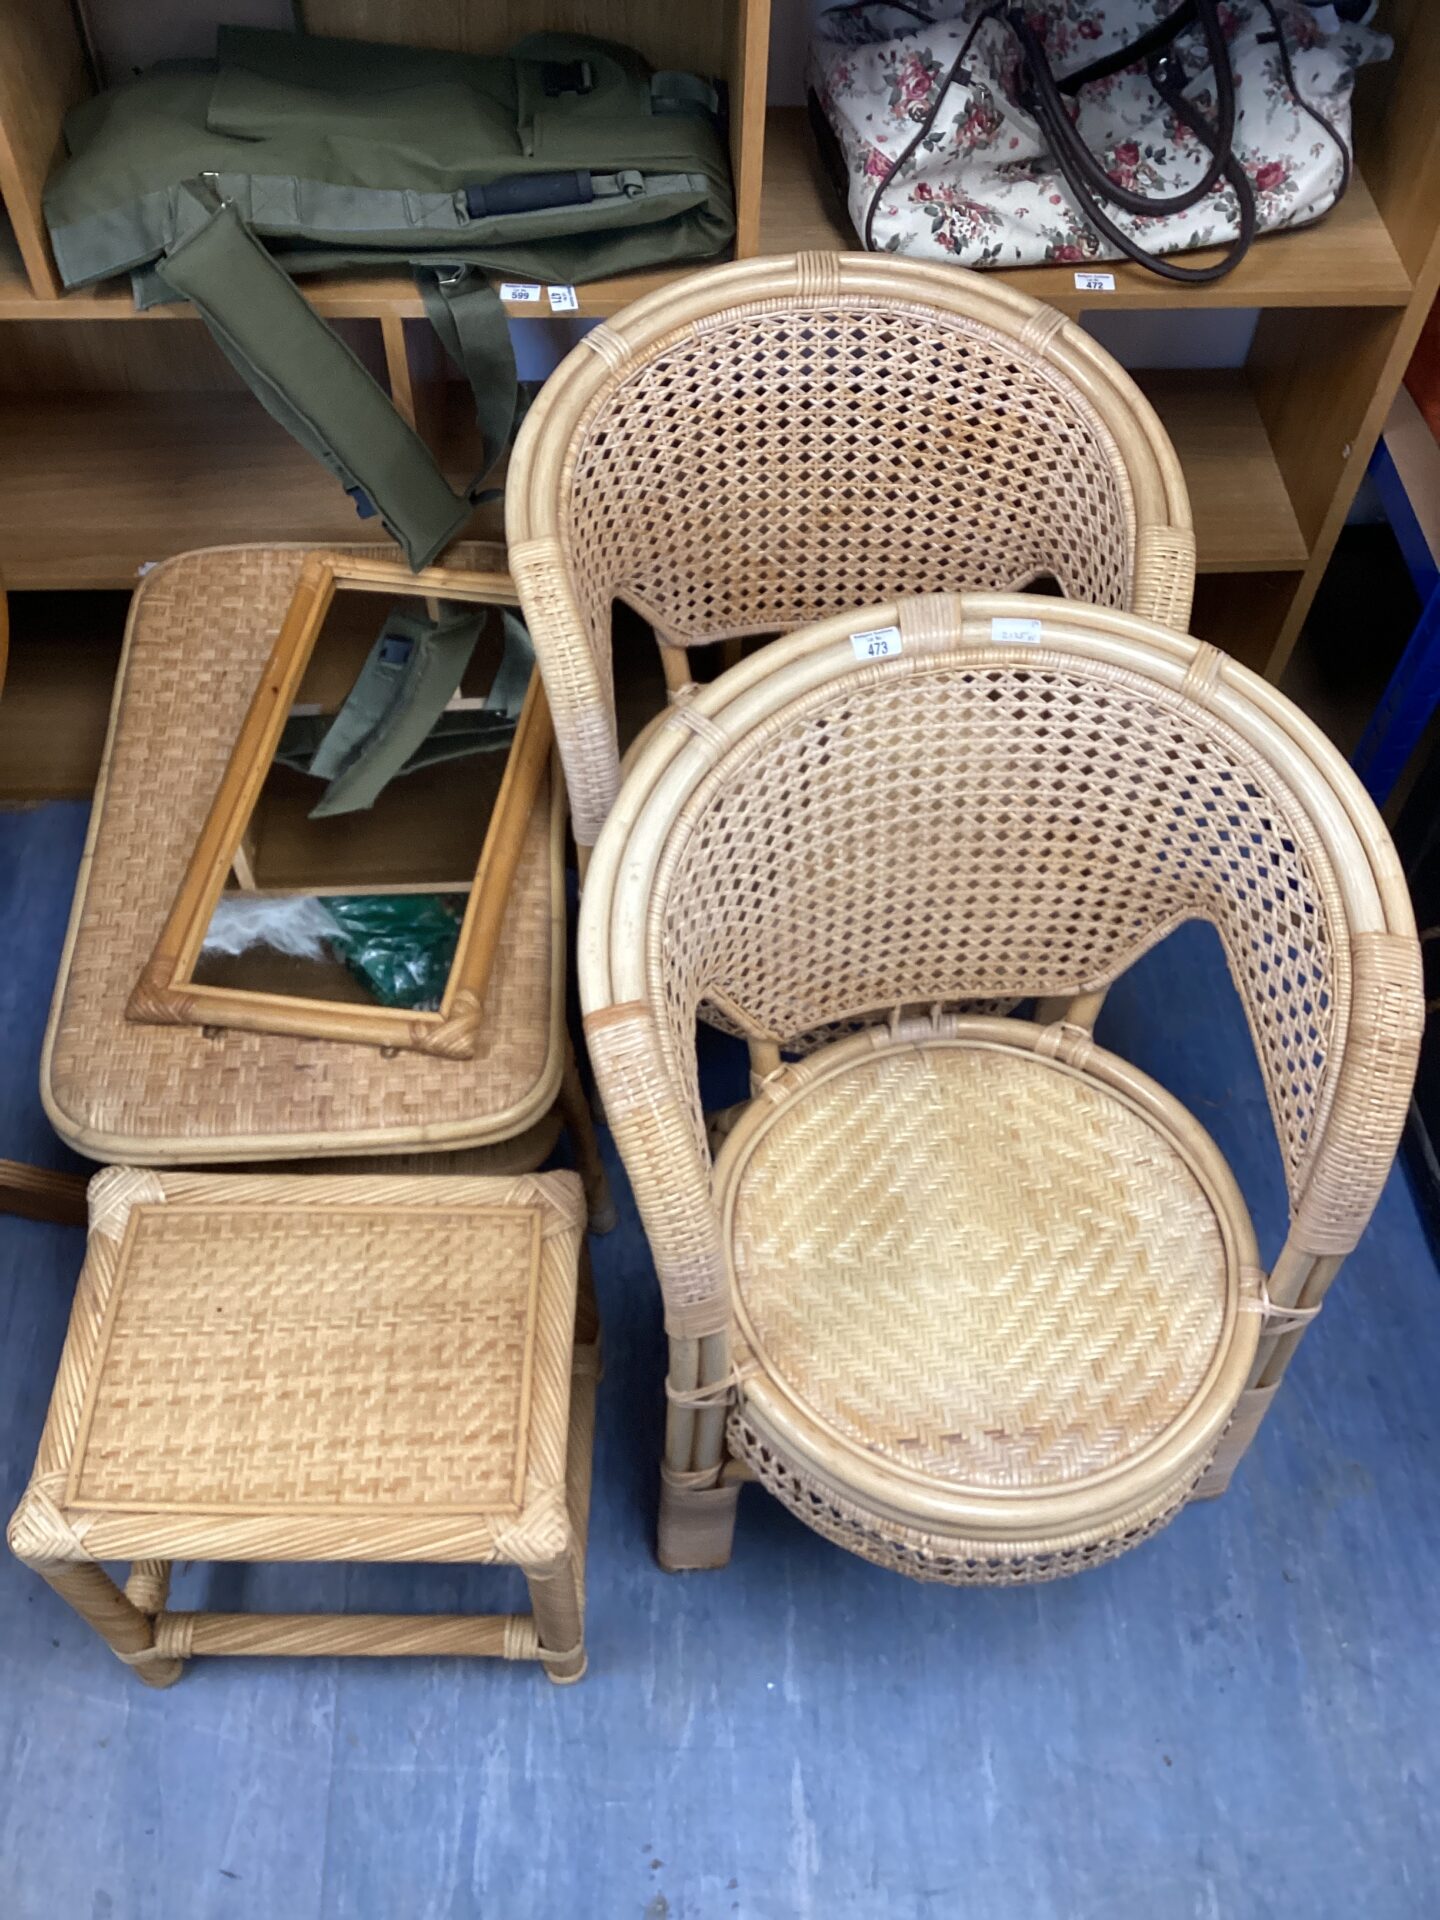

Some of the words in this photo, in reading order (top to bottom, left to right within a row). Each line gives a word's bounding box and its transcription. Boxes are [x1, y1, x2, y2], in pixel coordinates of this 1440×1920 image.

[1086, 281, 1103, 289] 472
[511, 292, 529, 300] 599
[868, 641, 888, 656] 473
